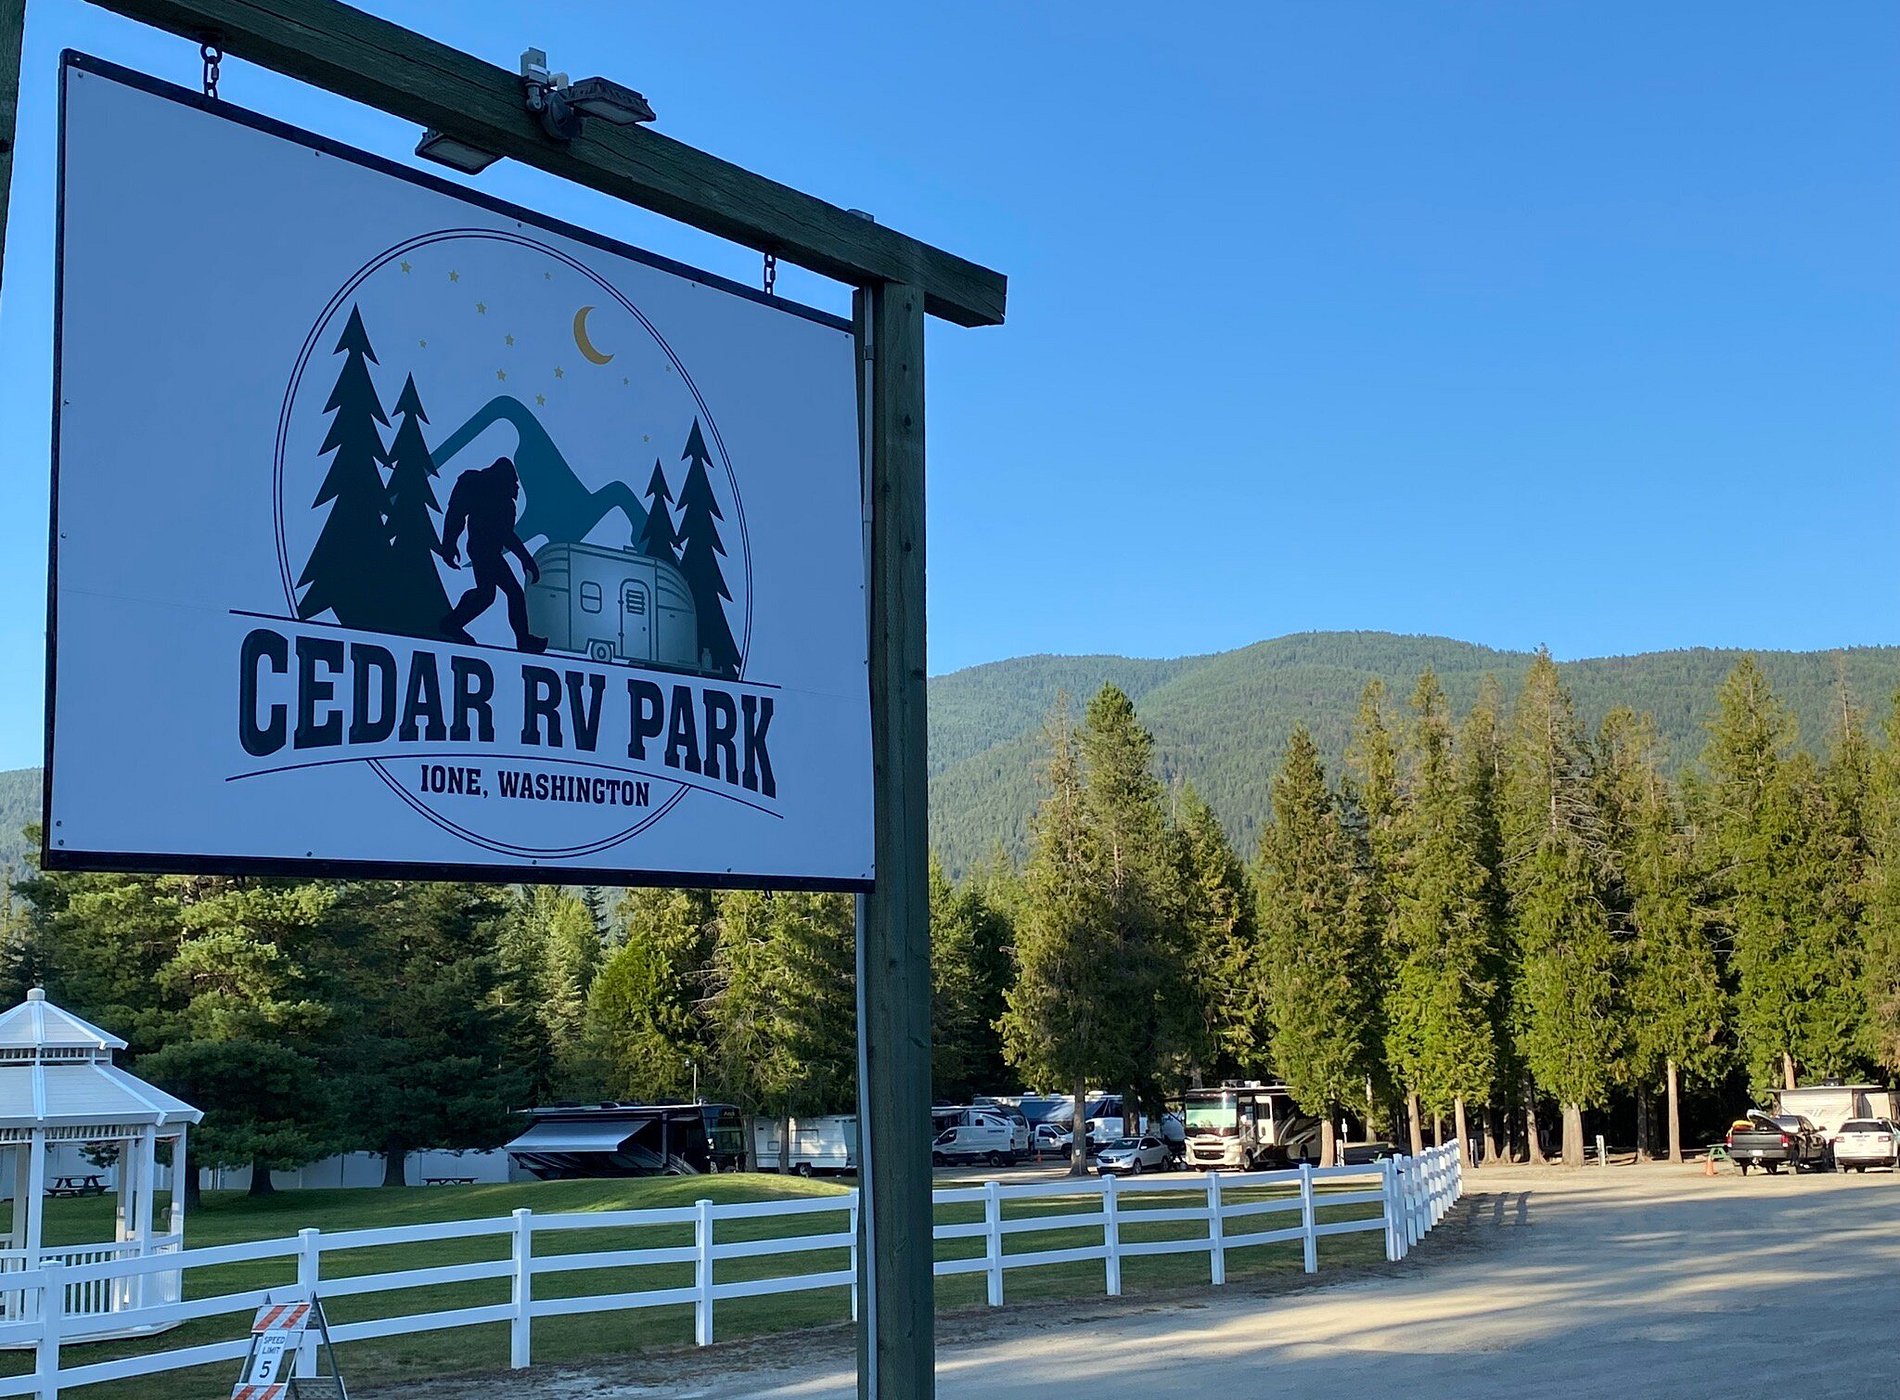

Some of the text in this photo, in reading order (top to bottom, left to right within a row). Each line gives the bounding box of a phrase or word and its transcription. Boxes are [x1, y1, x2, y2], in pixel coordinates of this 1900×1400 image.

[239, 628, 777, 799] CEDAR RV PARK
[420, 764, 650, 807] IONE, WASHINGTON
[263, 1336, 286, 1345] SPEED
[262, 1346, 281, 1355] LIMIT
[259, 1360, 272, 1379] 5
